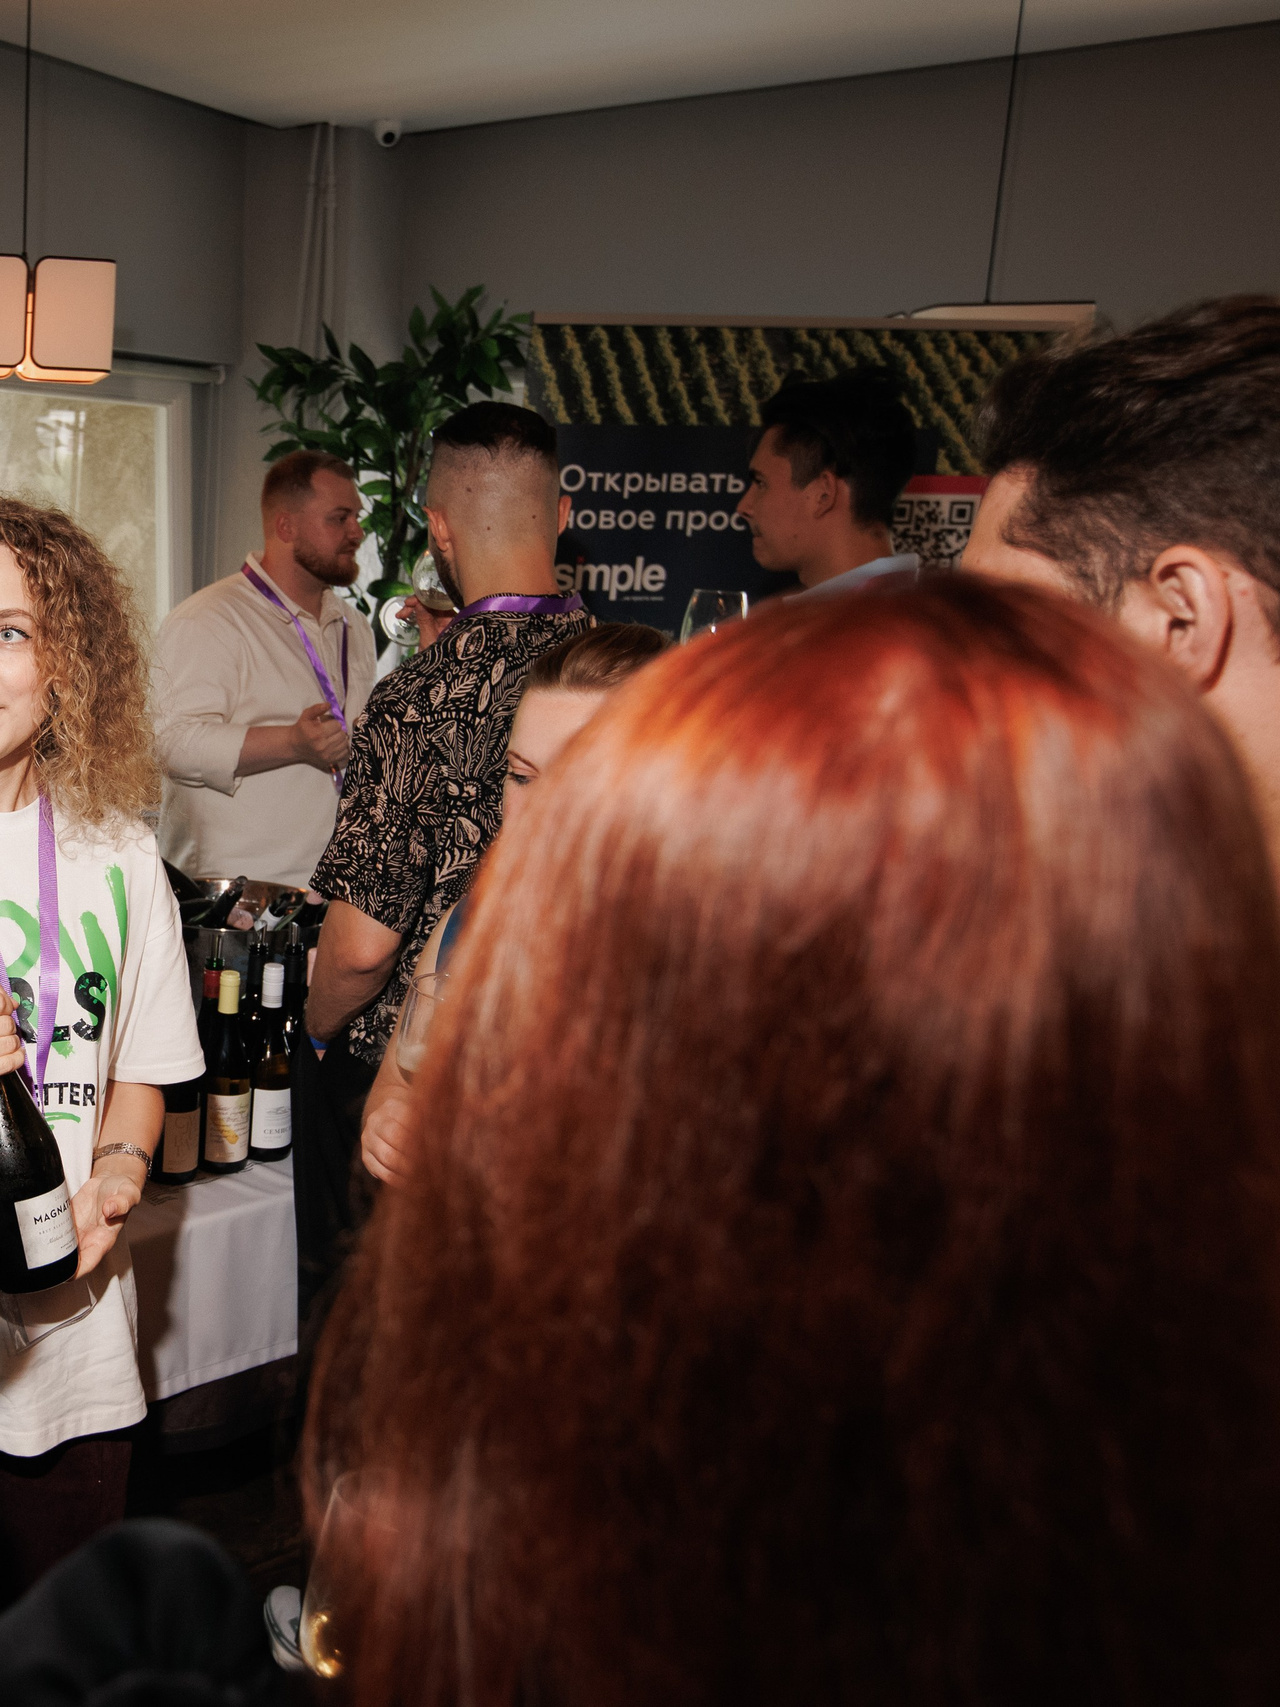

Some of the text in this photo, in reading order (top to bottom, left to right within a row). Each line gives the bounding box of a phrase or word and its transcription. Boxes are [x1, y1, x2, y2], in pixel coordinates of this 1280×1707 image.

[560, 463, 746, 499] Открывать
[665, 510, 748, 537] прос
[555, 555, 667, 601] simple
